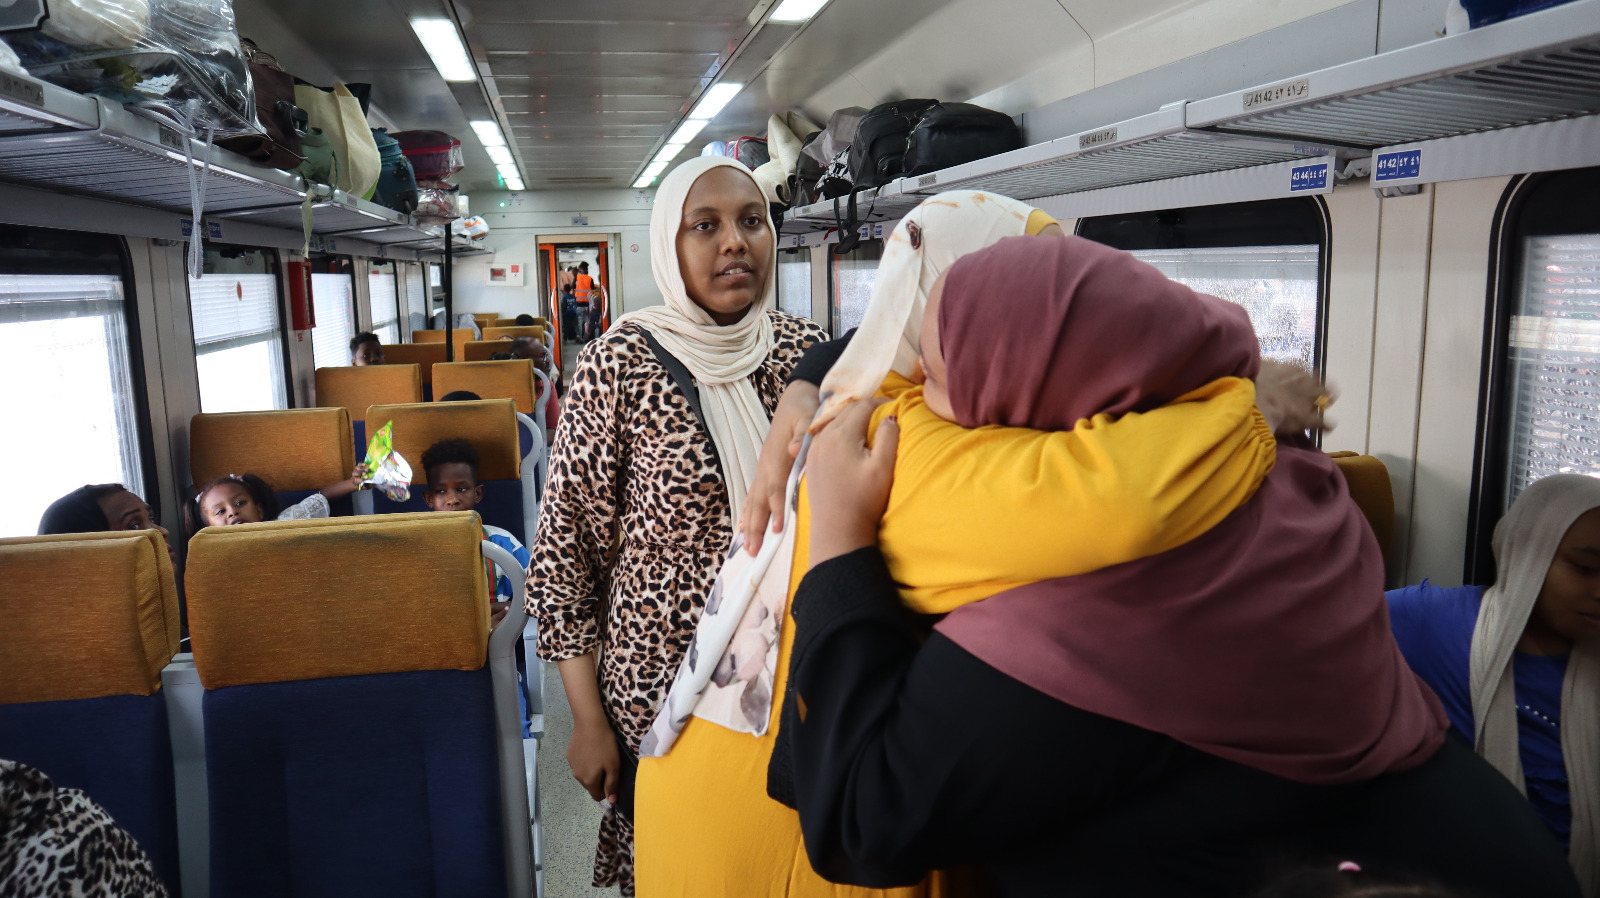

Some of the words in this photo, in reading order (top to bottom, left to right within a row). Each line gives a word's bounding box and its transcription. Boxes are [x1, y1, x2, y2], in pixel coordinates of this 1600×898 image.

[1254, 92, 1262, 104] 41
[1264, 89, 1273, 102] 42
[1276, 88, 1284, 99] ٤٢
[1287, 85, 1295, 96] ٤١
[1378, 159, 1387, 170] 41
[1387, 157, 1397, 169] 42
[1399, 156, 1409, 167] ٤٢
[1410, 155, 1420, 166] ٤١
[1292, 171, 1300, 181] 43
[1300, 171, 1308, 179] 44
